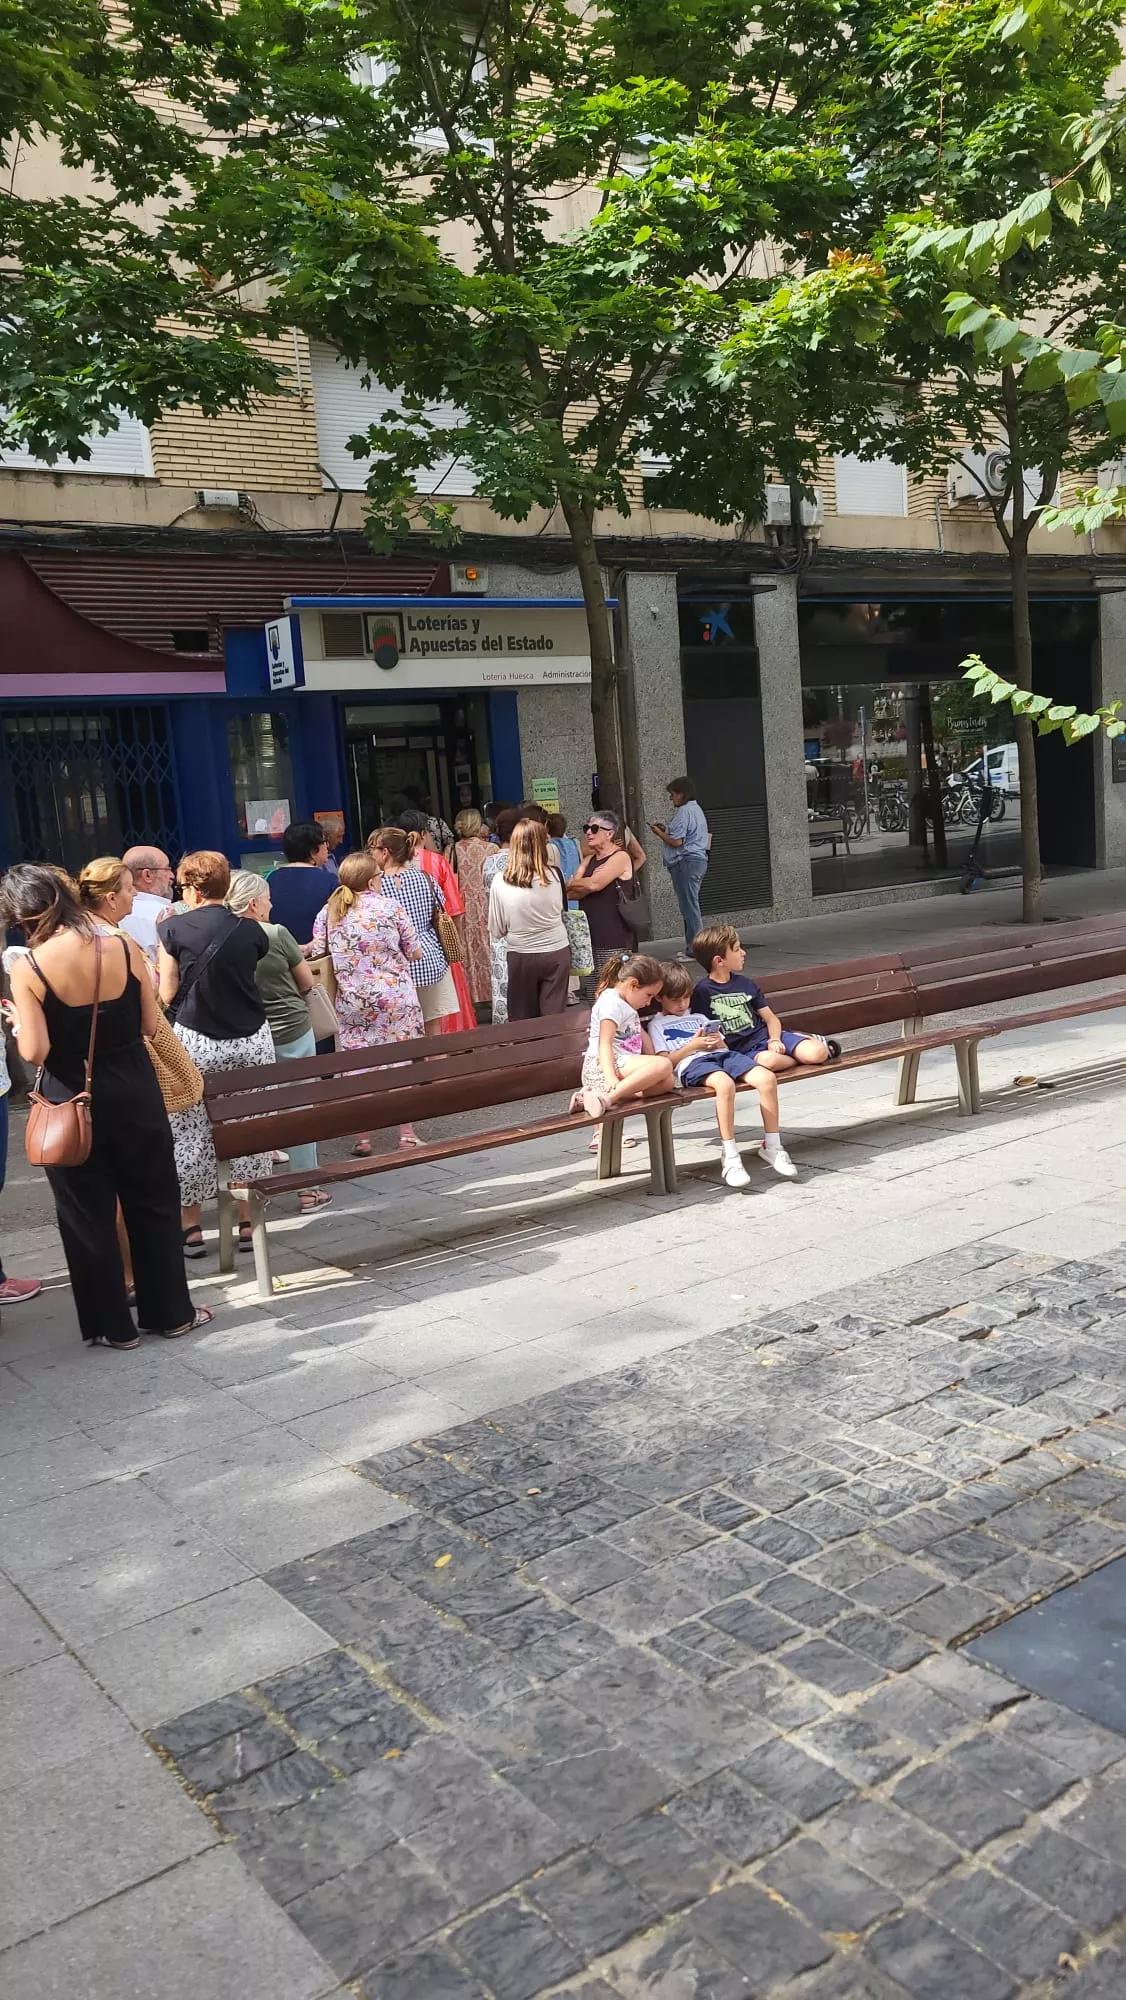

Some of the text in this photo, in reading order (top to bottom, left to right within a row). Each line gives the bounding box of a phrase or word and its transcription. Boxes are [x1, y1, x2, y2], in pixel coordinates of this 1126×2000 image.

[407, 615, 480, 634] Loterías y
[409, 634, 554, 656] Apuestas del Estado
[509, 671, 534, 680] Huesca
